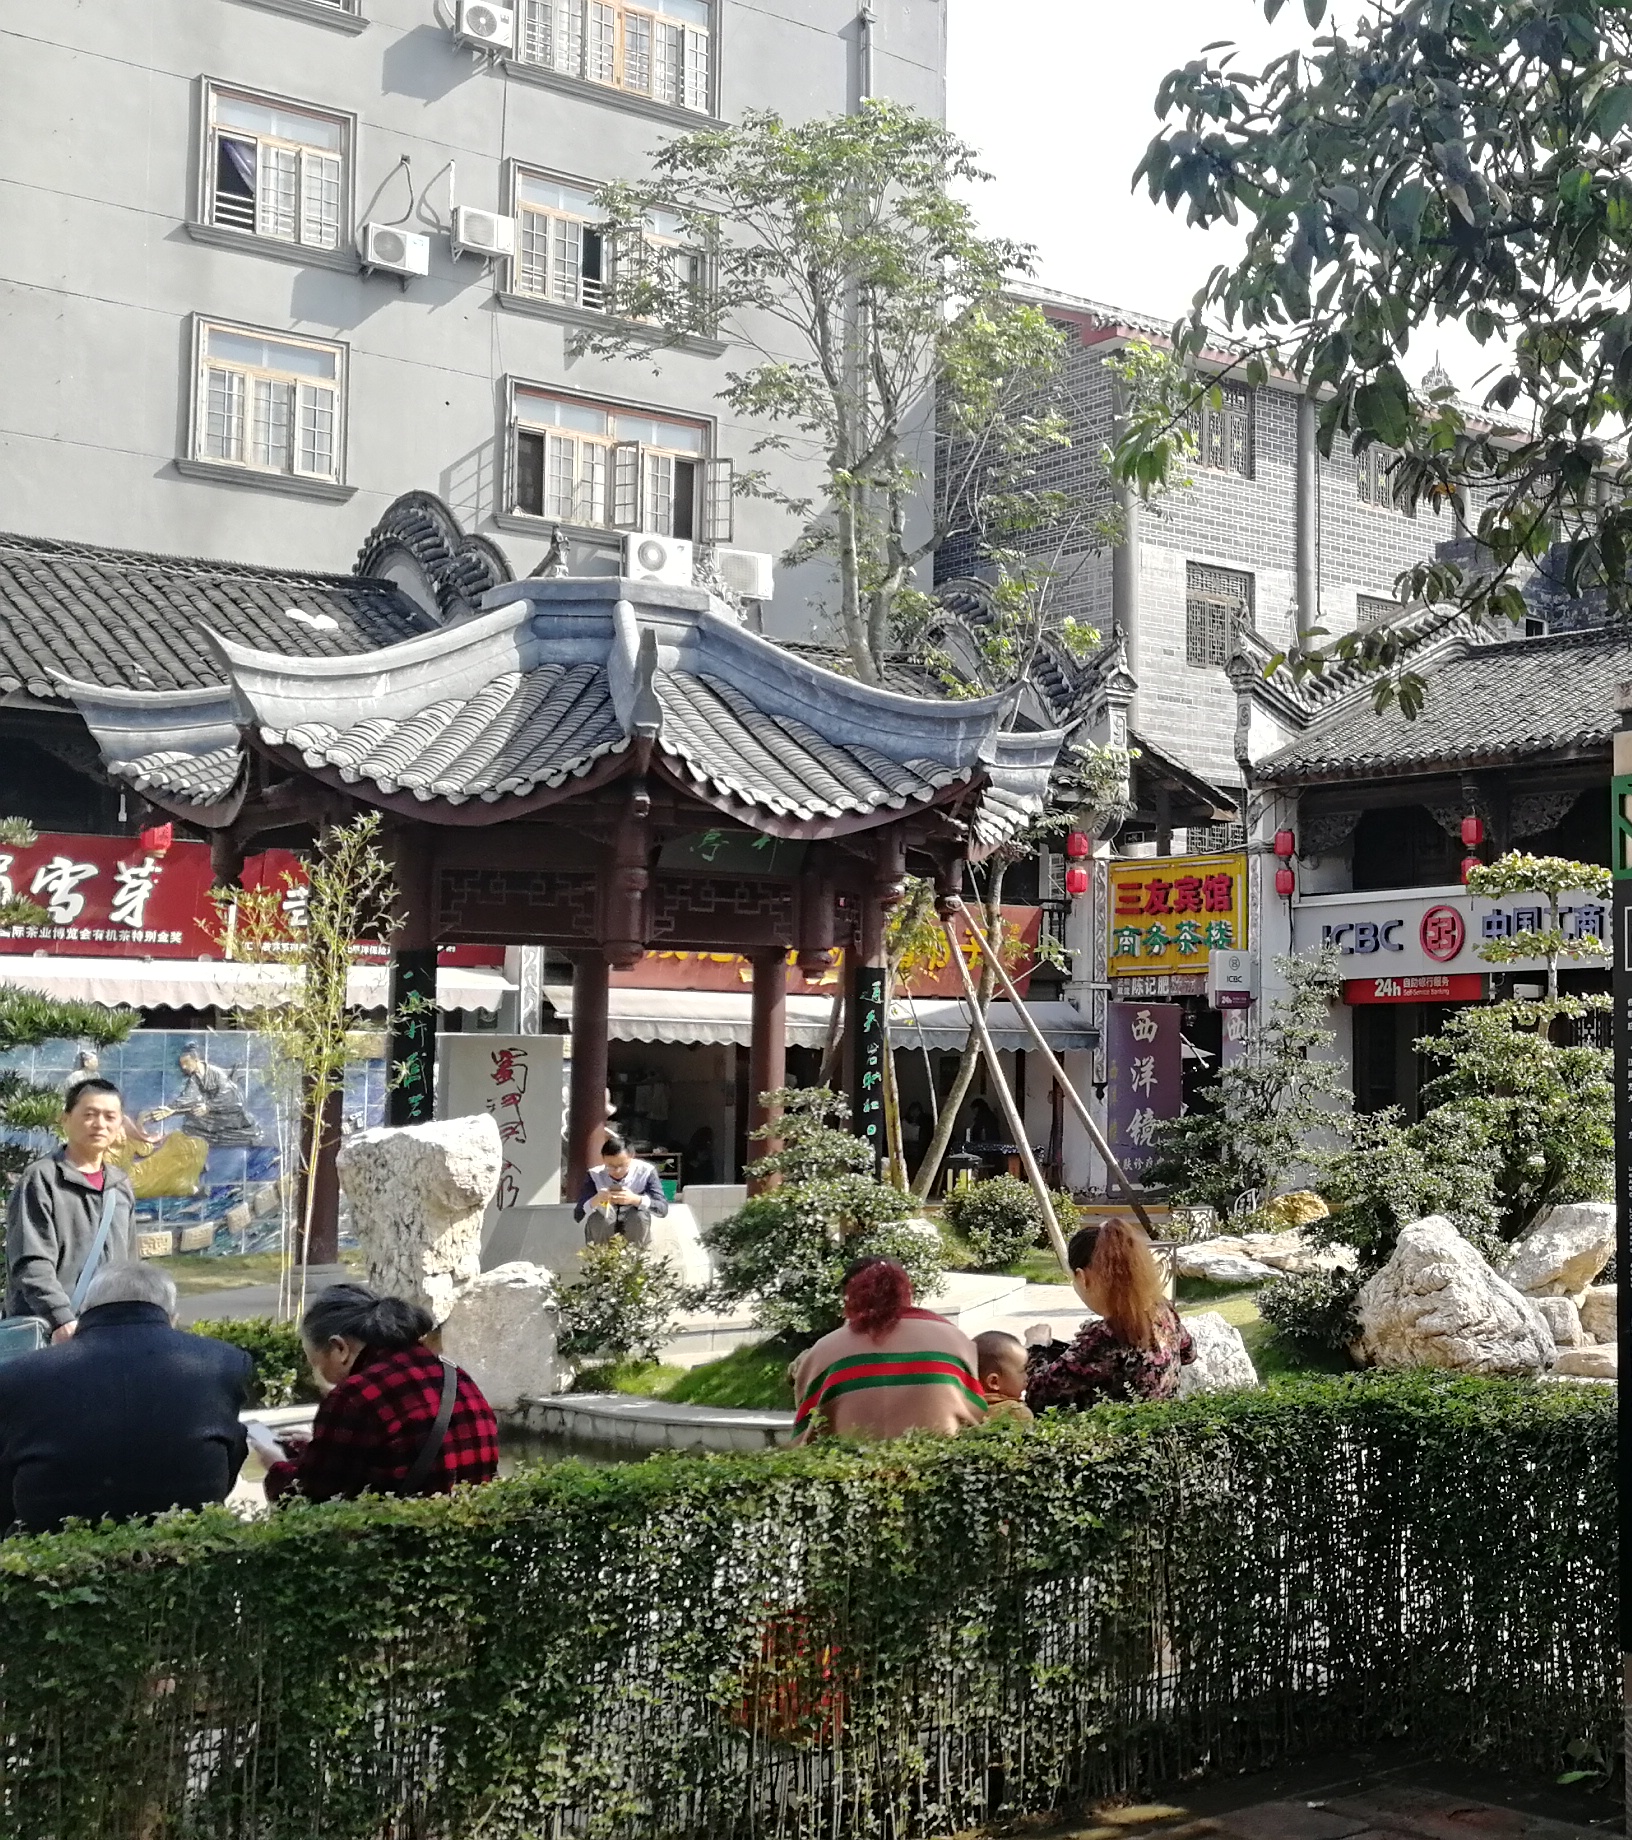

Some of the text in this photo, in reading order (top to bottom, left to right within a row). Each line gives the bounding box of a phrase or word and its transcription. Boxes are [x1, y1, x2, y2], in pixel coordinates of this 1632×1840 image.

[1115, 873, 1233, 915] 三友宾馆
[0, 926, 183, 944] 际茶业博览会有机茶特别金奖
[1113, 919, 1237, 957] 商务茶楼
[1322, 919, 1404, 955] ICBC
[1226, 975, 1243, 983] ICBC
[1374, 978, 1401, 997] 24h
[1126, 1010, 1158, 1147] 西洋镜
